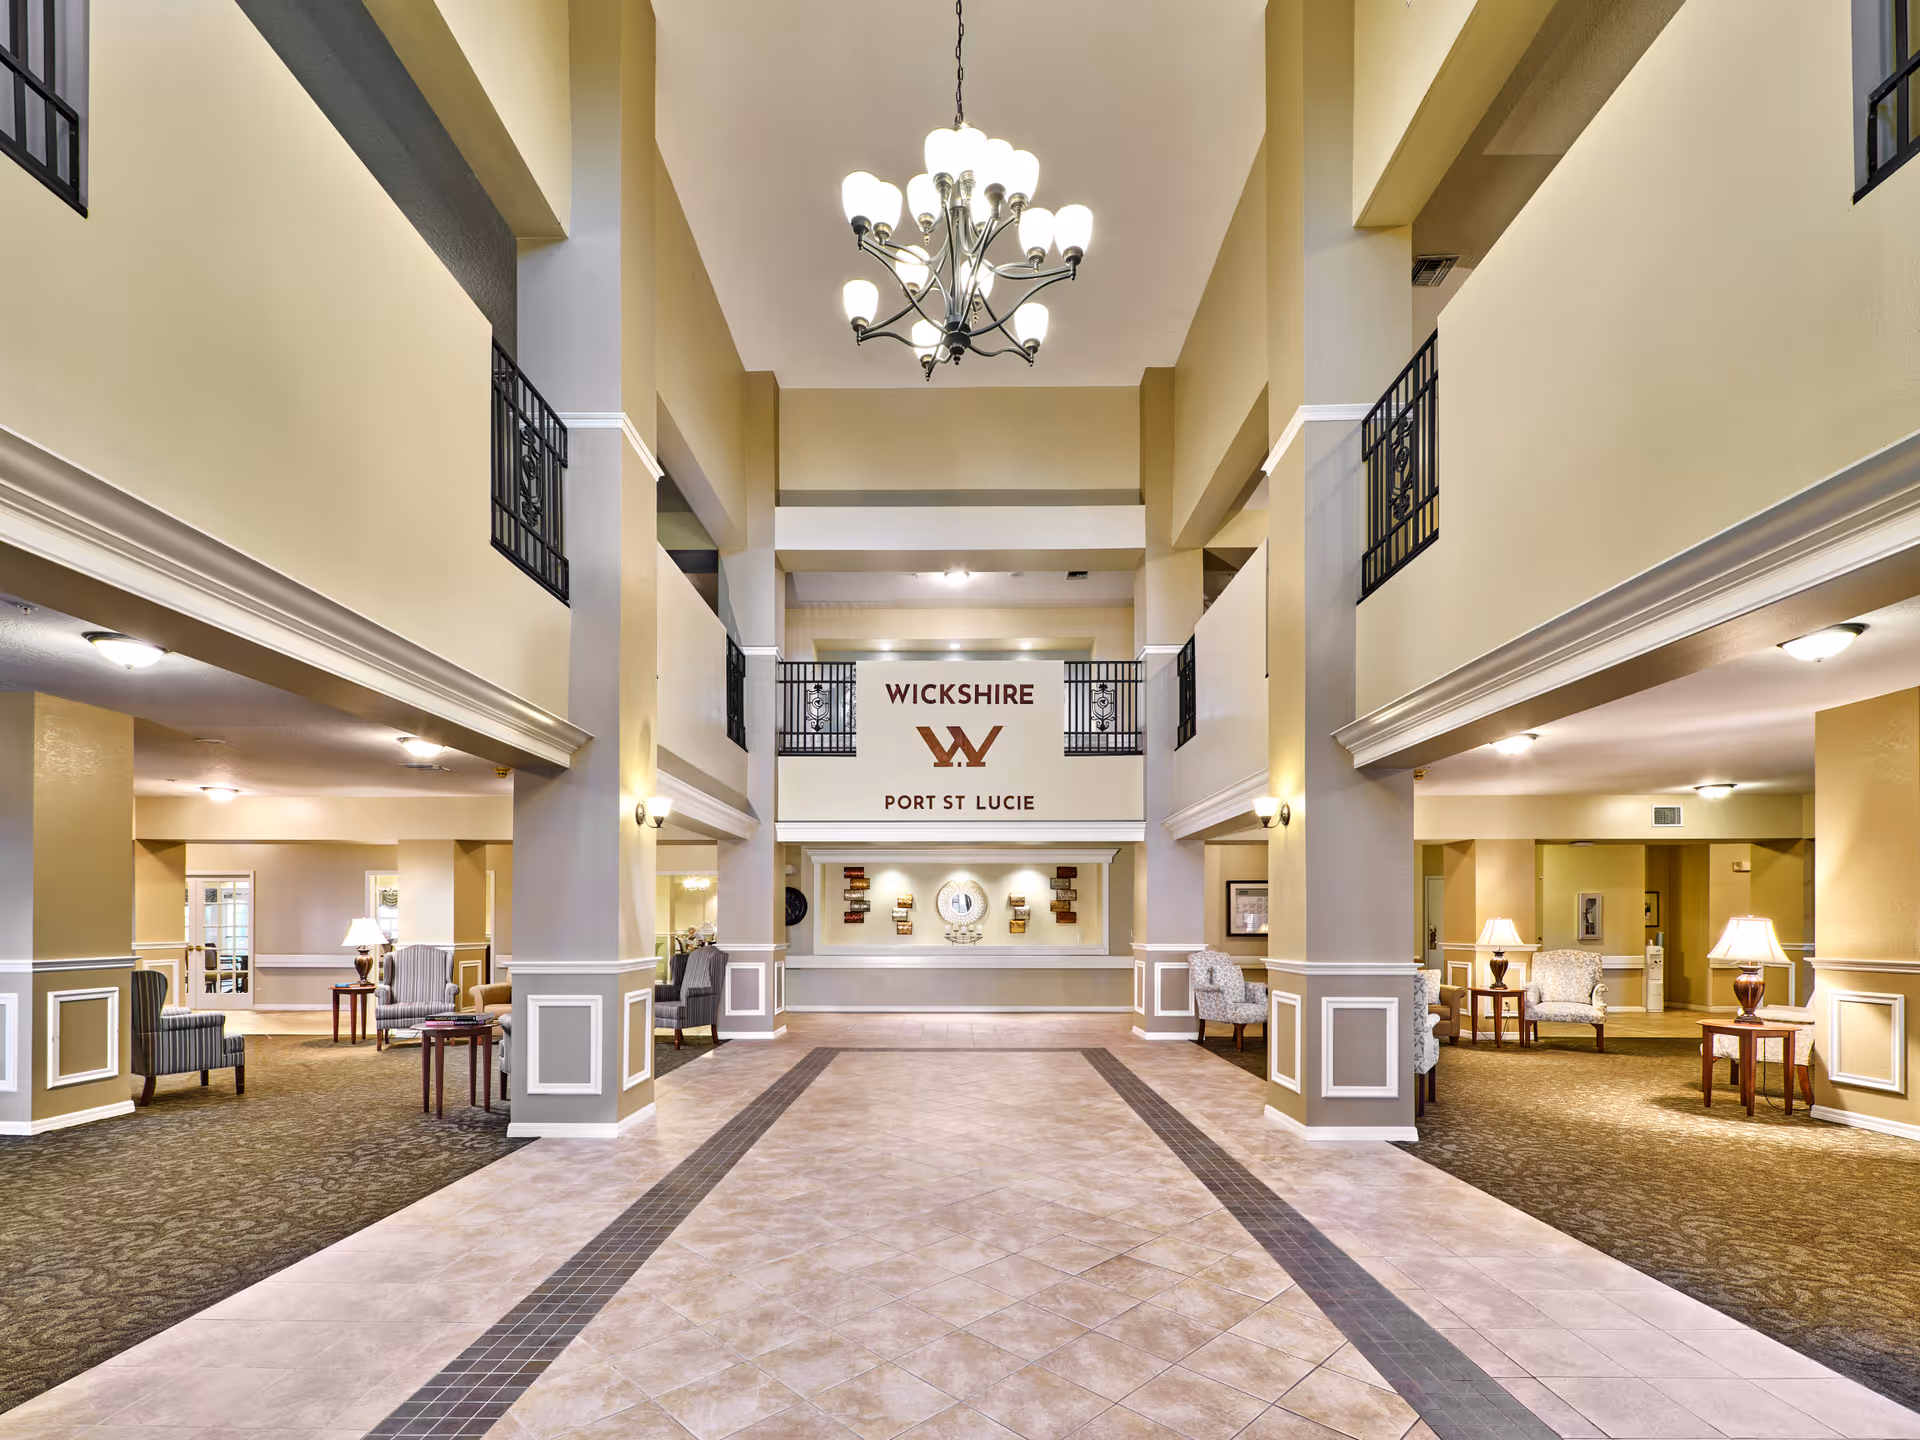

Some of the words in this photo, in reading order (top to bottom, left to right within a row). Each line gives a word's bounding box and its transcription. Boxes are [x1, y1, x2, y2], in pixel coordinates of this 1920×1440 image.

[885, 683, 1035, 705] WICKSHIRE
[885, 795, 936, 810] PORT
[943, 795, 966, 810] ST
[976, 795, 1035, 810] LUCIE
